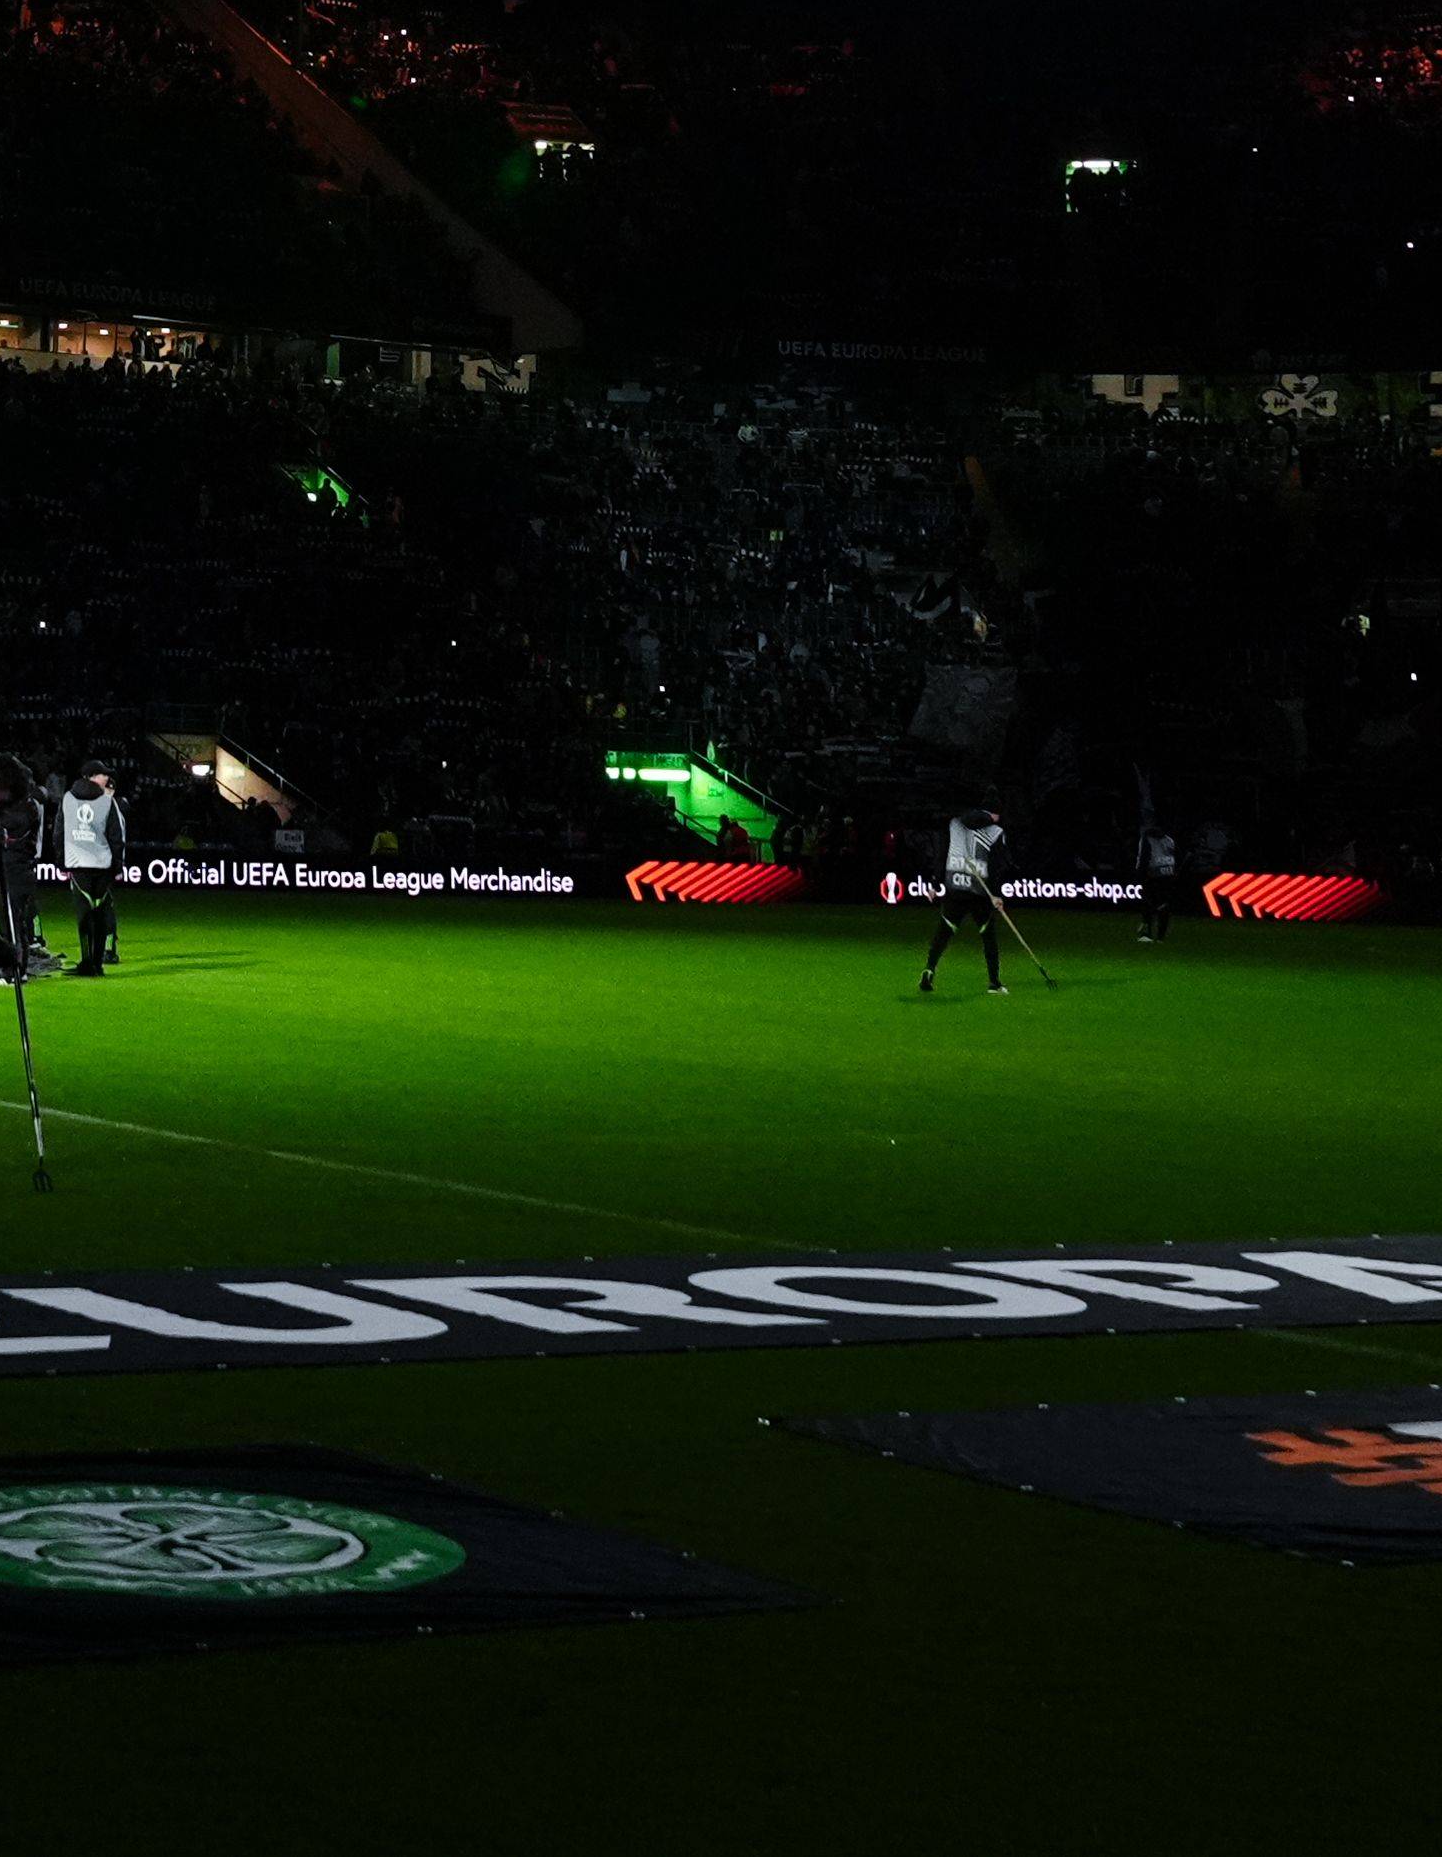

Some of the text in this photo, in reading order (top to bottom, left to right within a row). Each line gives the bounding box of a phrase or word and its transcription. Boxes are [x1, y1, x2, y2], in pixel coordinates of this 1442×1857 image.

[777, 340, 830, 360] UEFA
[830, 341, 908, 361] EUROPA
[233, 861, 290, 886] UEFA
[373, 866, 445, 896] League
[451, 867, 574, 894] Merchandise
